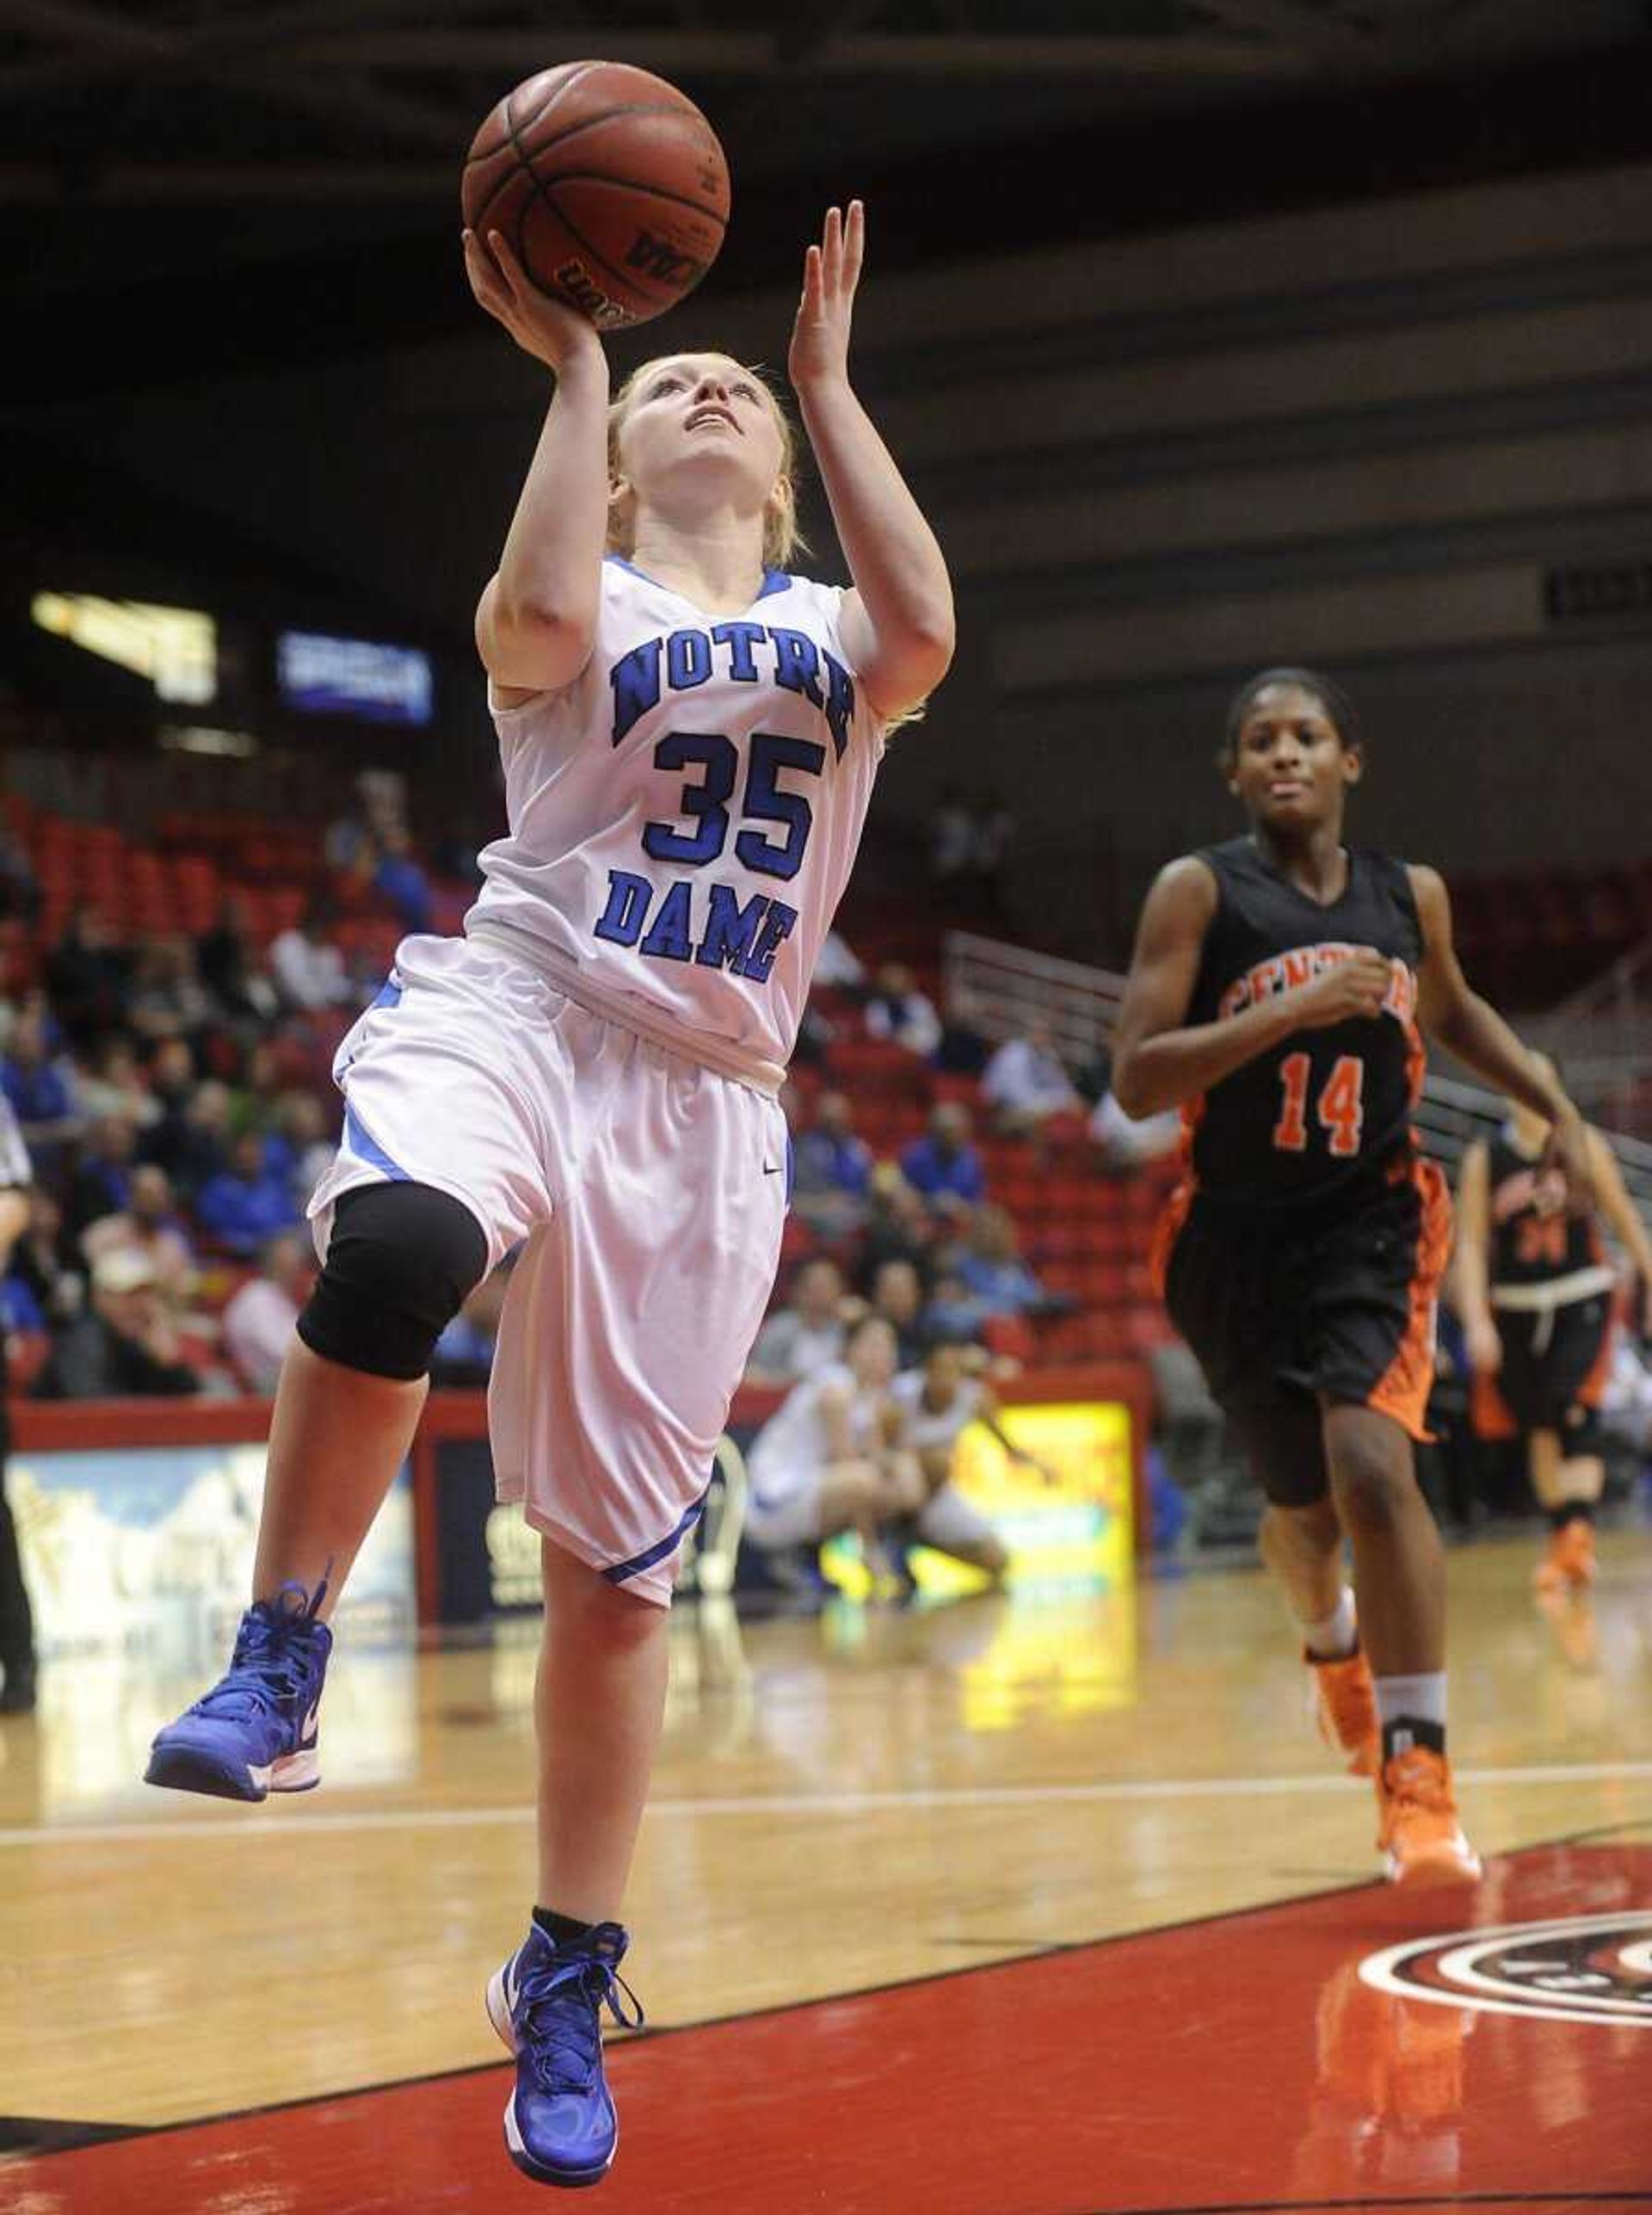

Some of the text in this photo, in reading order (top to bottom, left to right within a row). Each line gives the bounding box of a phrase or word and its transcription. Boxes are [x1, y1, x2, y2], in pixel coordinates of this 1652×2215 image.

[641, 731, 826, 881] 35
[594, 869, 798, 983] DAME
[1273, 1052, 1364, 1157] 14
